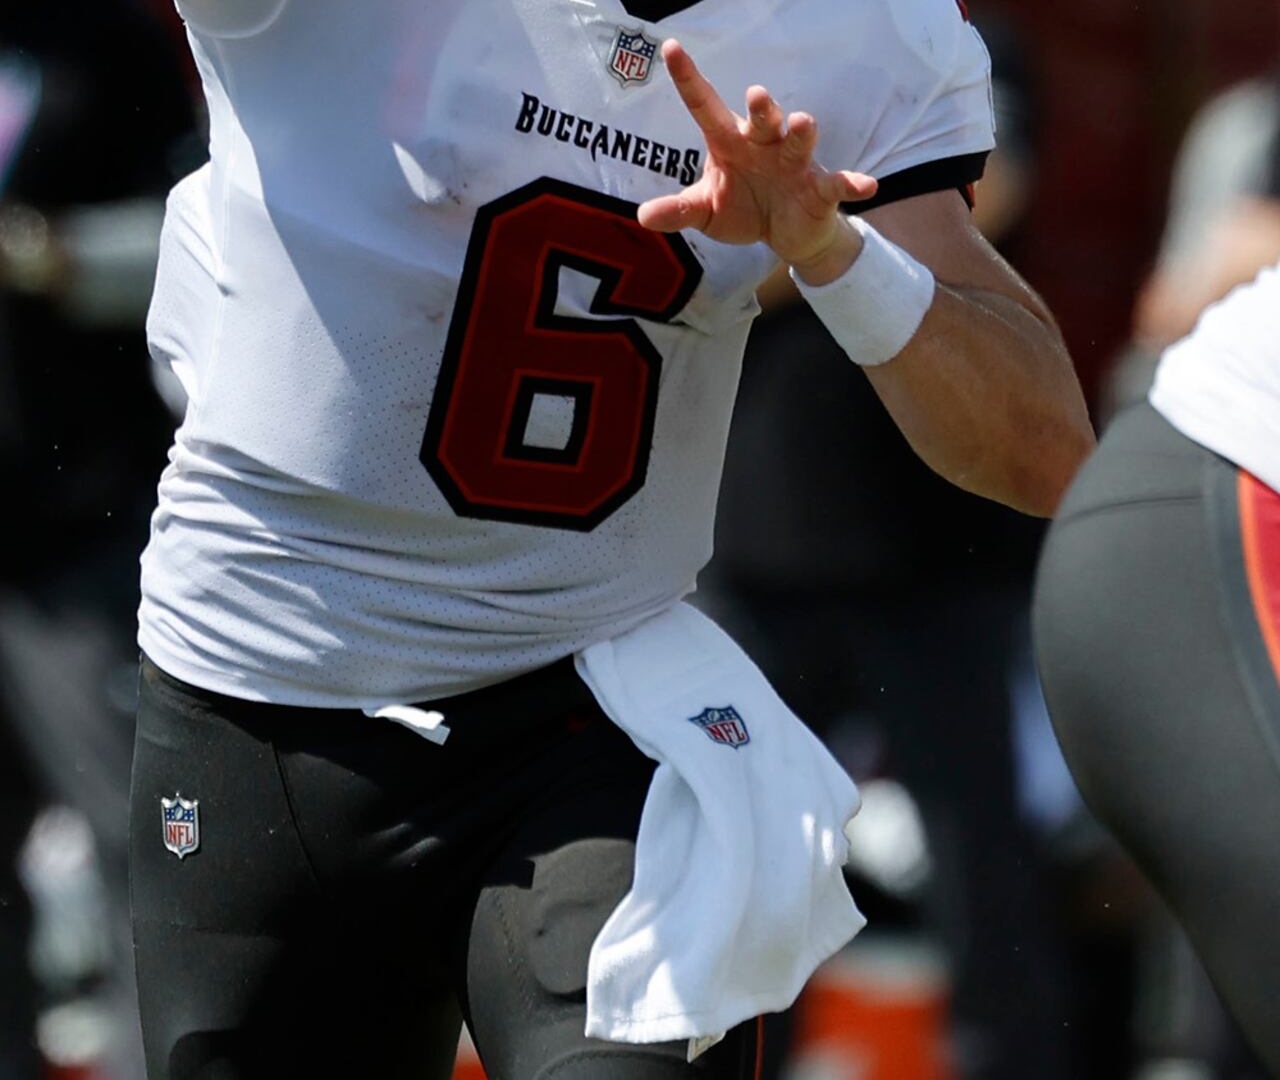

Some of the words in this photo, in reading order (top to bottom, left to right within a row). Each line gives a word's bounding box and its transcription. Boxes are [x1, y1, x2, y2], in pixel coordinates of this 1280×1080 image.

[614, 49, 647, 78] NFL
[515, 90, 700, 187] BUCCANEERS
[419, 176, 704, 532] 6
[704, 721, 746, 744] NFL
[168, 824, 193, 847] NFL
